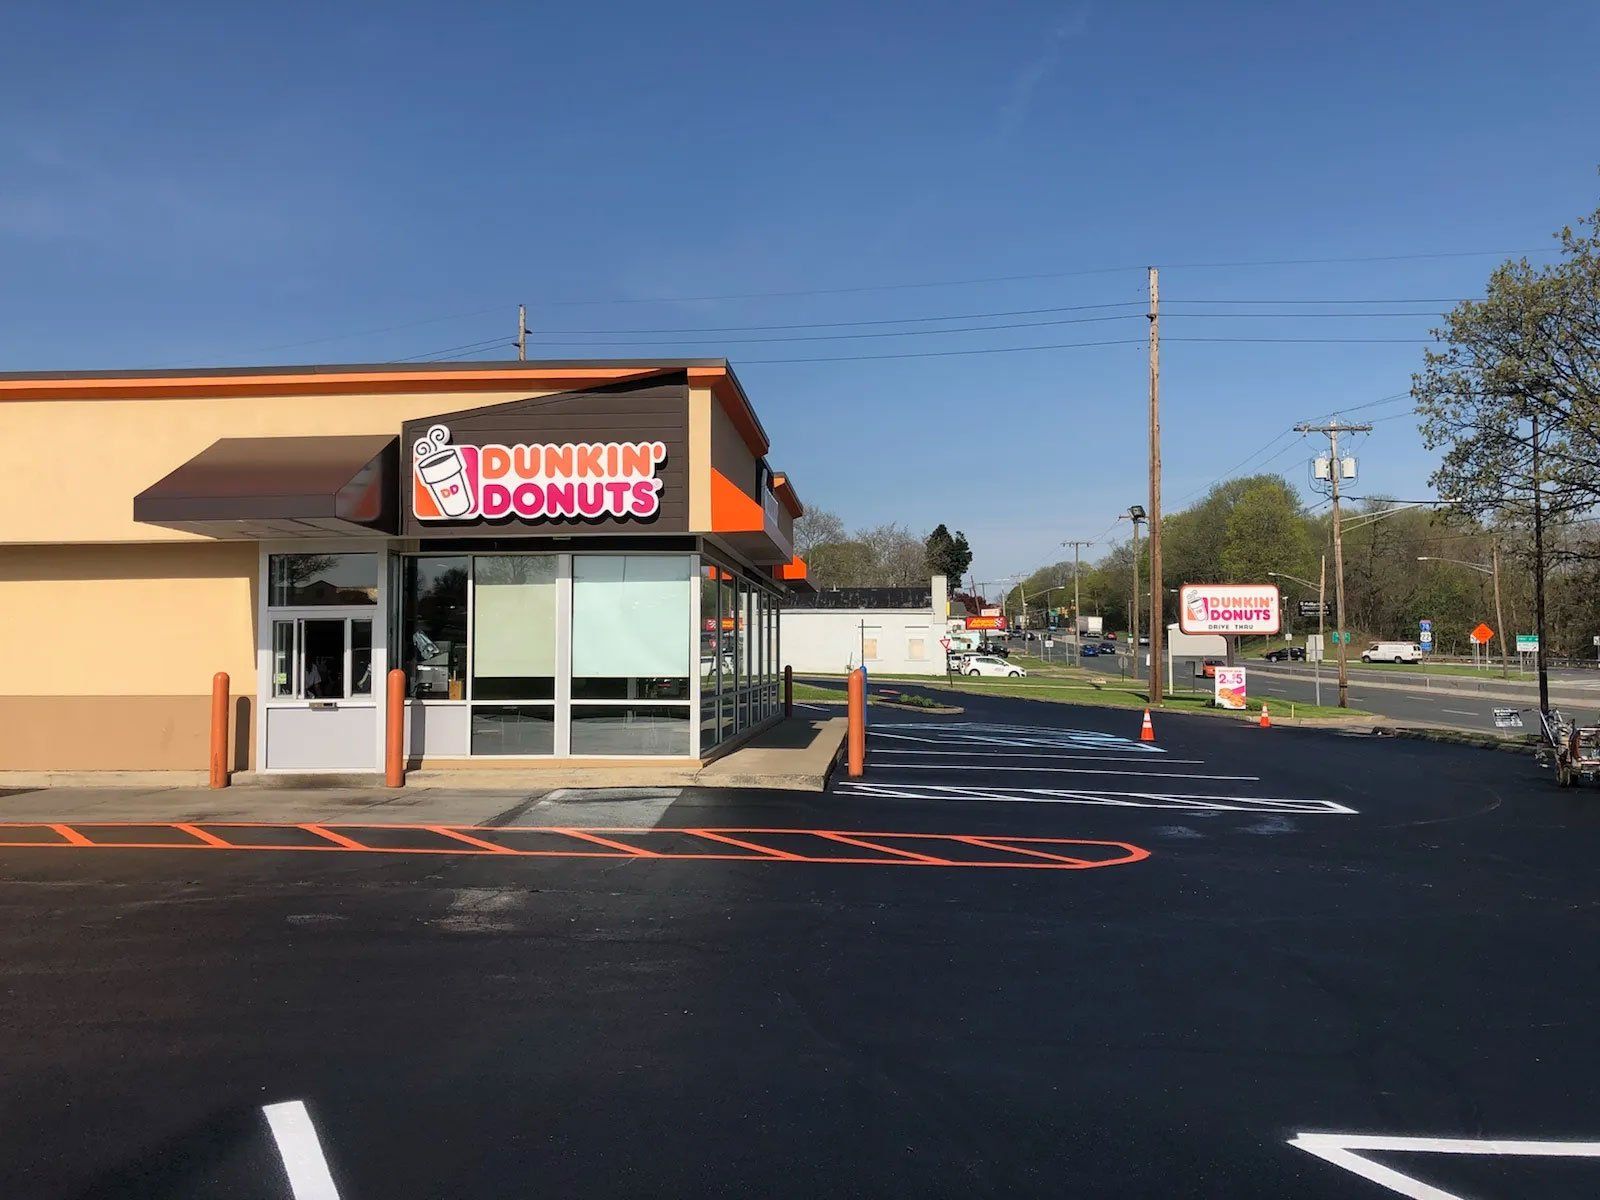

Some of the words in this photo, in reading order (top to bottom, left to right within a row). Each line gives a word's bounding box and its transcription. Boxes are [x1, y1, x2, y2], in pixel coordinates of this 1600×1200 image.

[482, 445, 662, 479] DUNKIN'
[483, 481, 654, 515] DONUTS
[1210, 597, 1273, 608] DUNKIN'
[1211, 609, 1271, 620] DONUTS
[1219, 673, 1226, 684] 2
